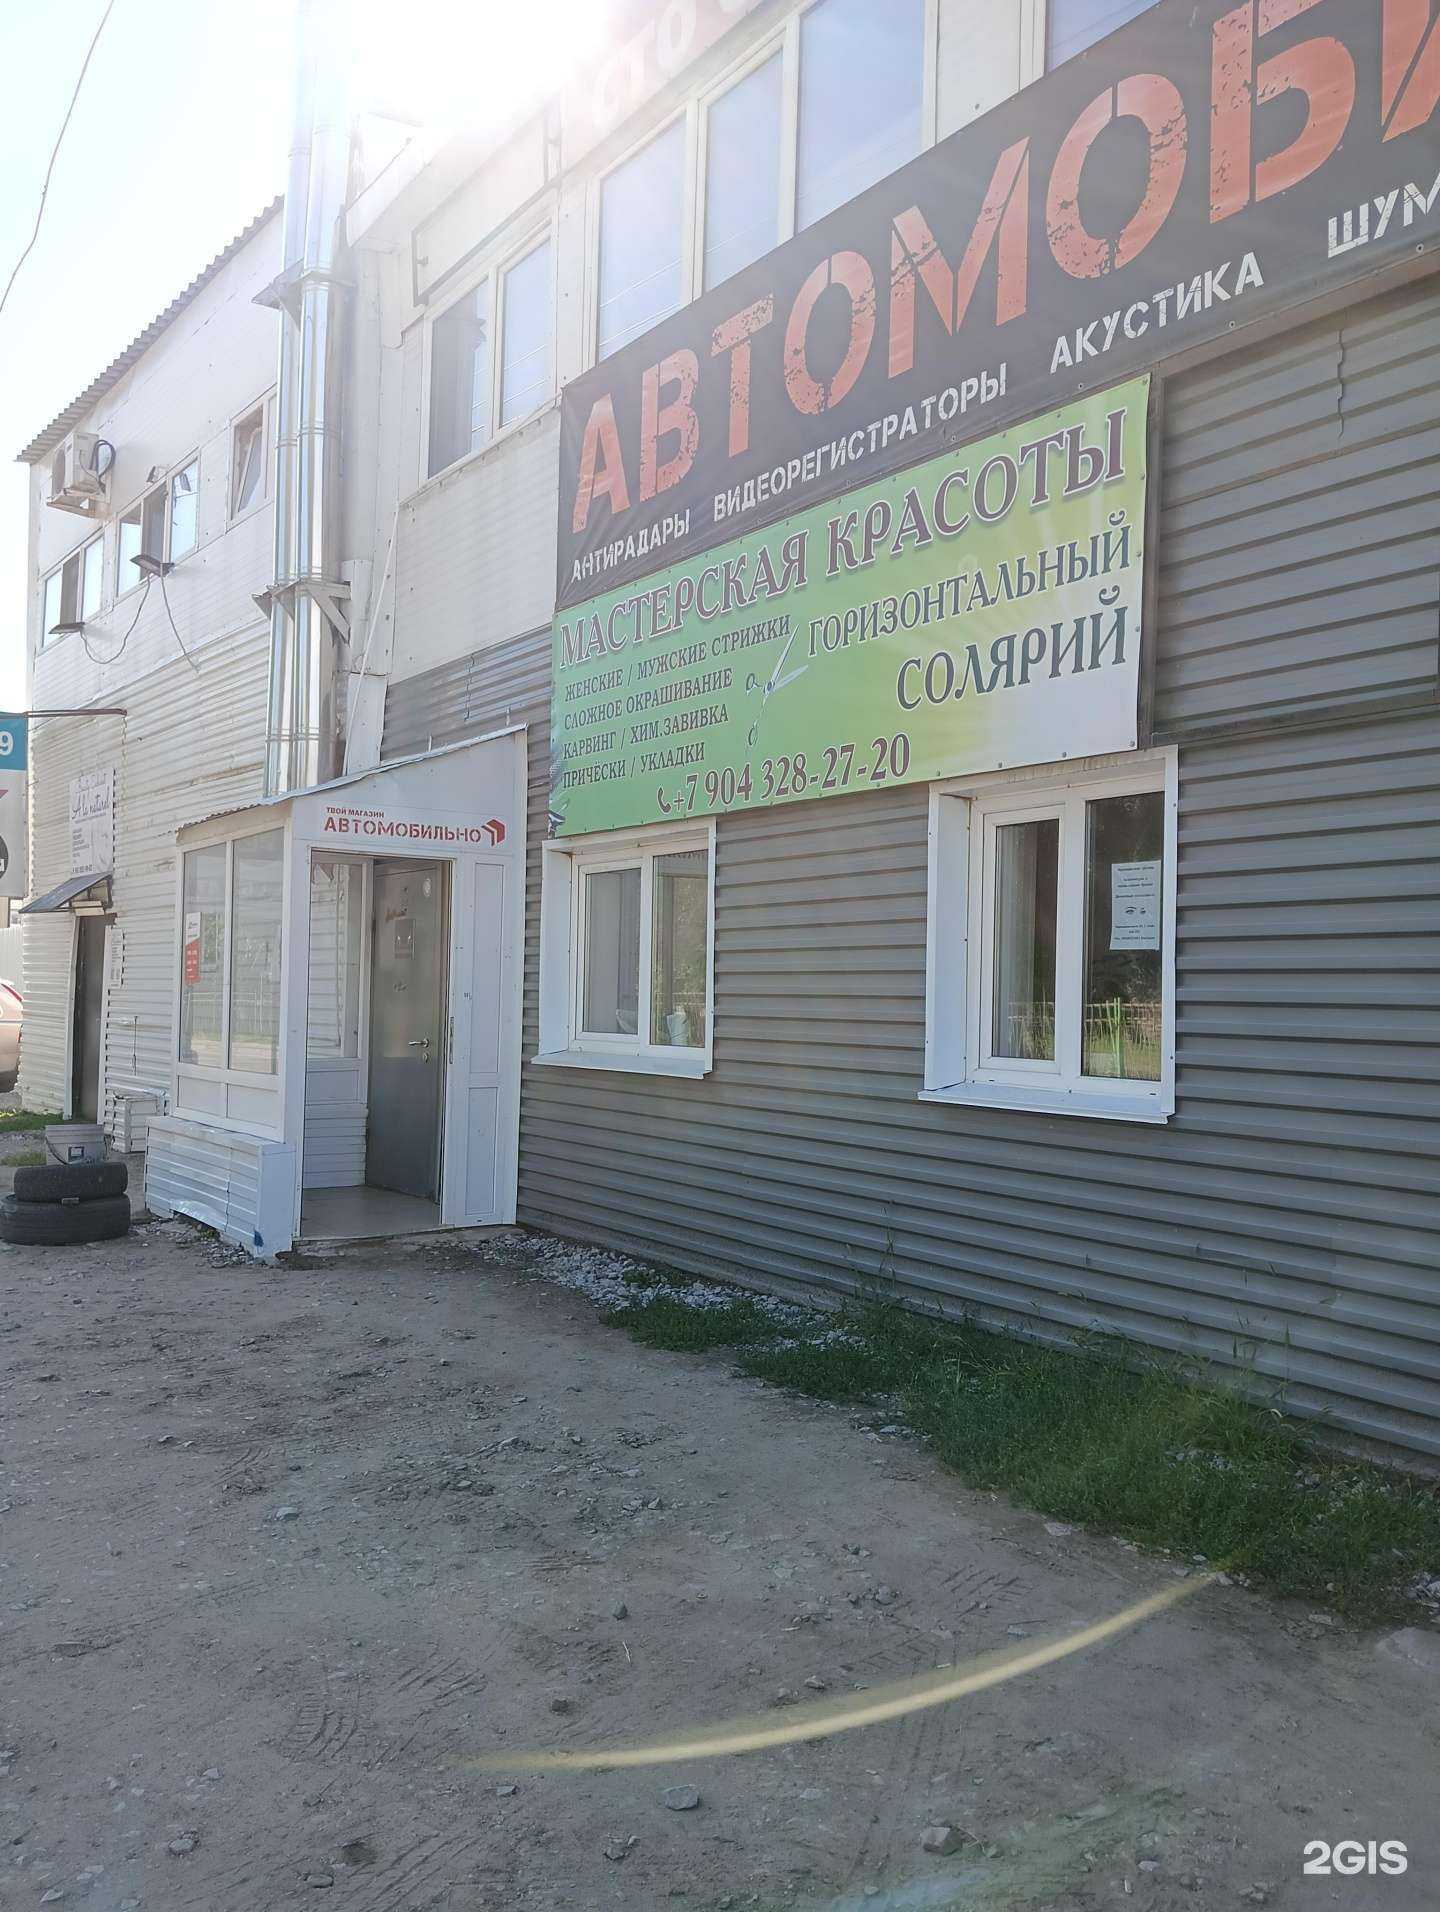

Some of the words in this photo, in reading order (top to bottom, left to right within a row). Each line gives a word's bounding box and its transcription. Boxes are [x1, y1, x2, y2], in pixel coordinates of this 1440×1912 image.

[570, 508, 692, 584] АНТИРАДАРЫ
[713, 362, 1008, 523] ВИДЕОРЕГИСТРАТОРЫ
[1050, 251, 1265, 374] АКУСТИКА
[560, 529, 810, 669] МАСТЕРСКАЯ
[826, 408, 1126, 577] КРАСОТЫ
[808, 509, 1130, 657] ГОРИЗОНТАЛЬНЫЙ
[565, 668, 623, 702] ЖЕНСКИЕ
[637, 641, 707, 681] МУЖСКИЕ
[711, 614, 791, 658] СТРИЖКИ
[896, 585, 1128, 712] СОЛЯРИЙ
[563, 732, 616, 760] КАРВИНГ
[630, 703, 729, 745] ХИМ.ЗАВИВКА
[564, 699, 623, 730] СЛОЖНОЕ
[626, 668, 733, 714] ОКРАШИВАНИЕ
[640, 741, 705, 773] УКЛАДКИ
[704, 763, 752, 807] 904
[761, 732, 910, 801] 328-27-20
[324, 816, 482, 843] АВТОМОБИЛЬНО
[348, 808, 385, 818] МАГАЗИН
